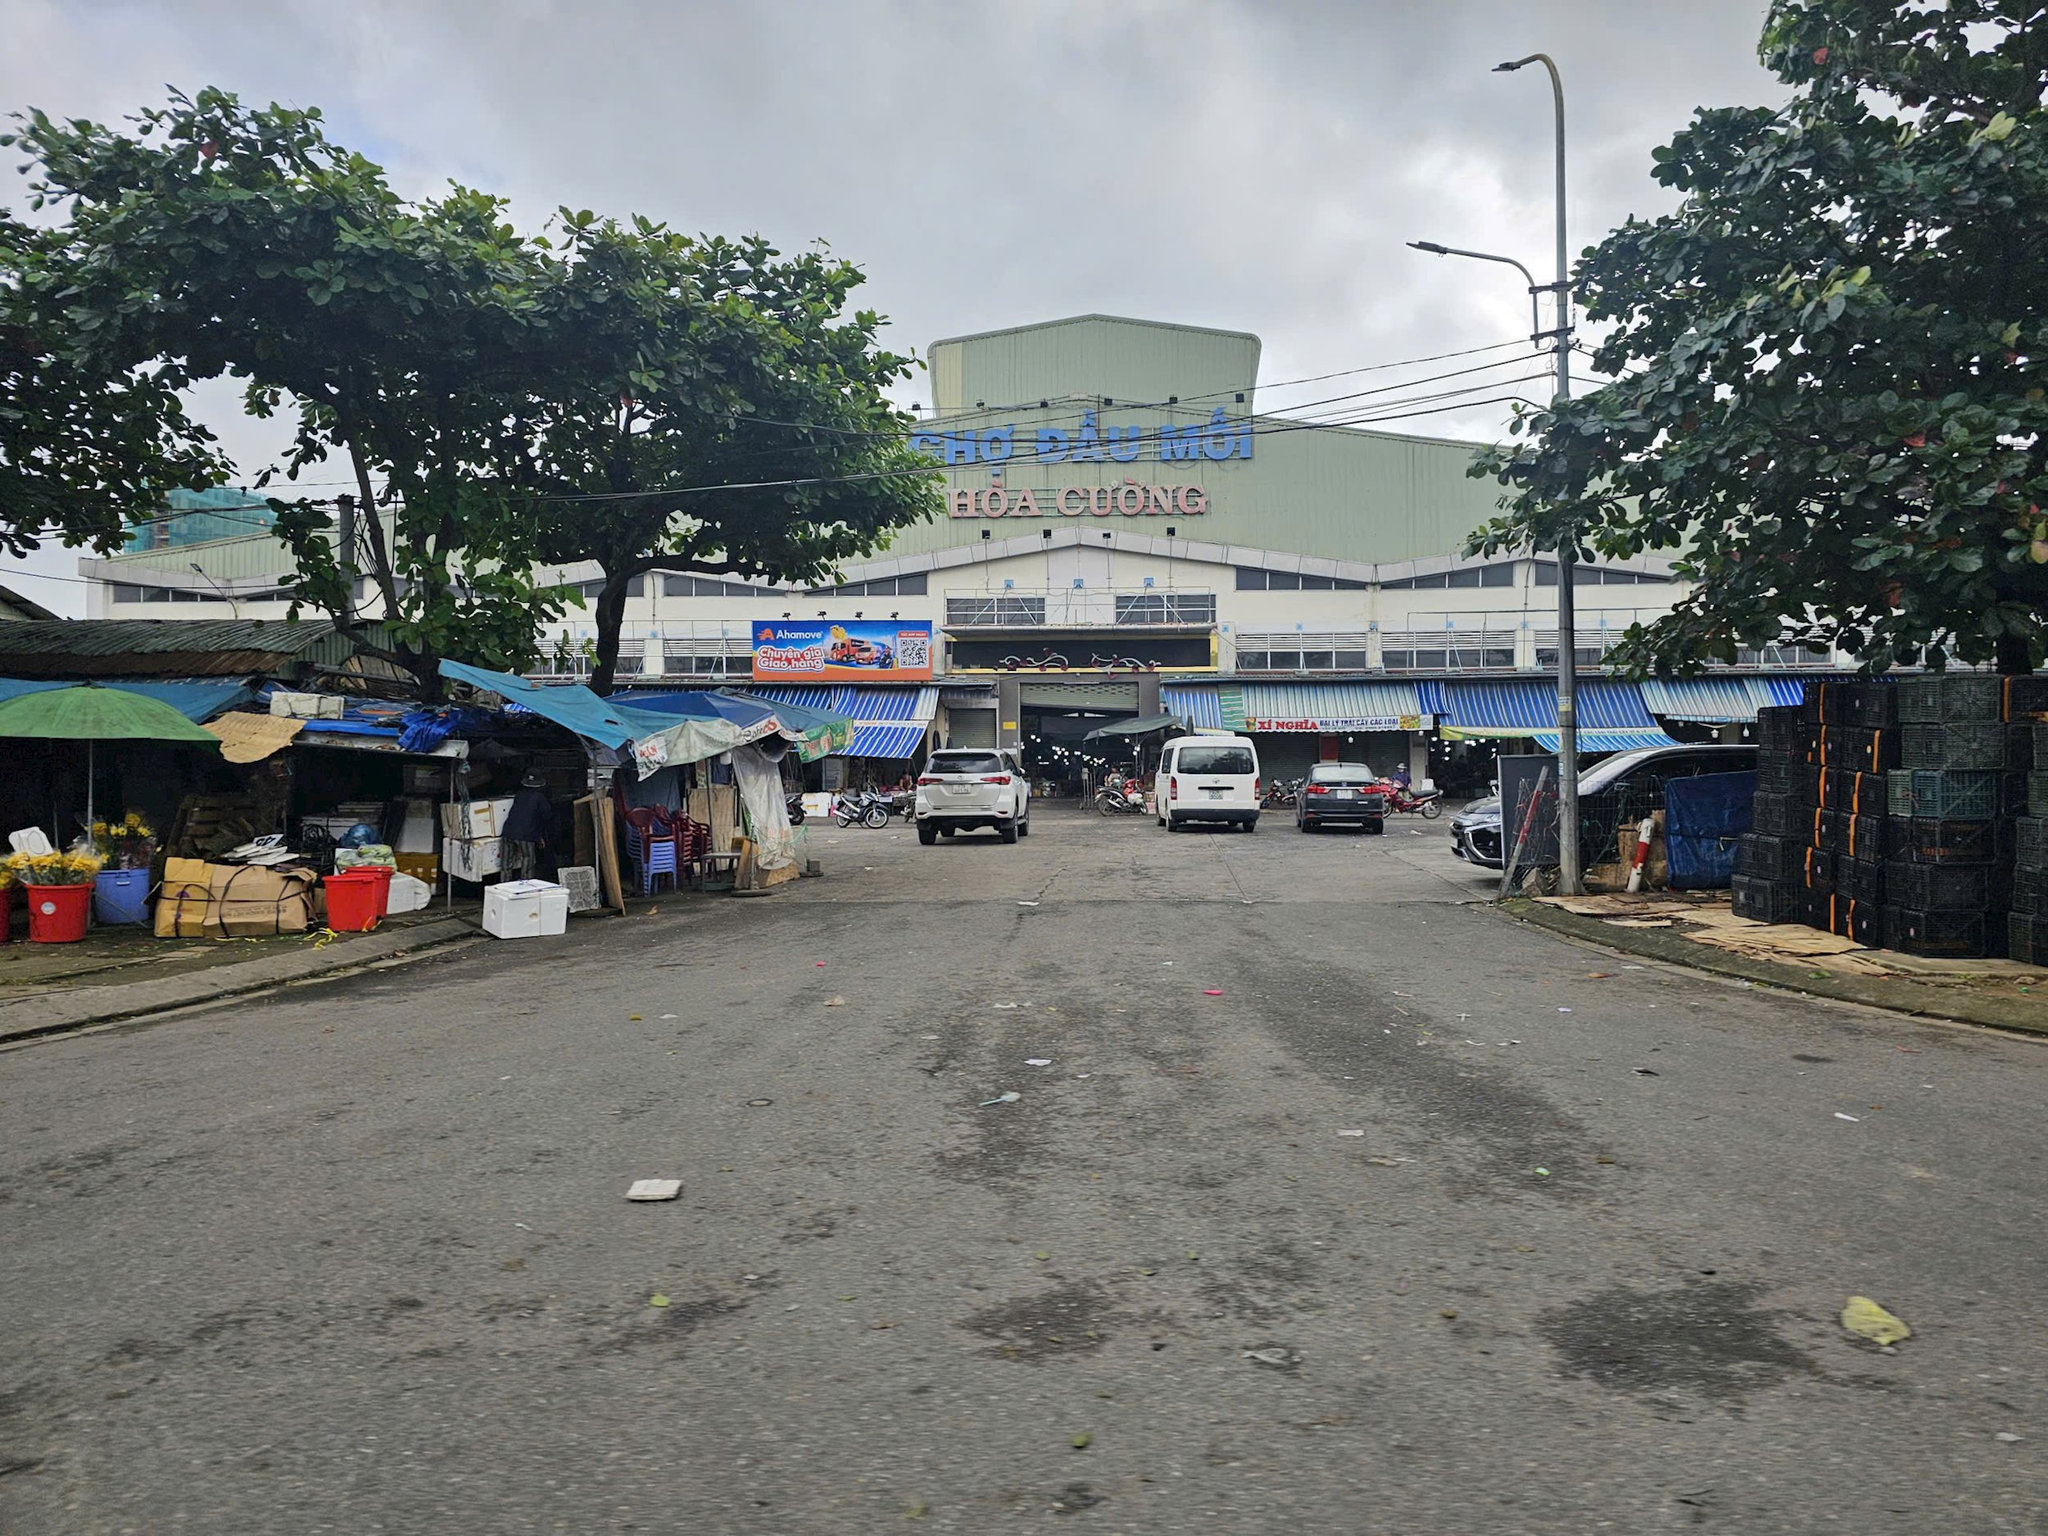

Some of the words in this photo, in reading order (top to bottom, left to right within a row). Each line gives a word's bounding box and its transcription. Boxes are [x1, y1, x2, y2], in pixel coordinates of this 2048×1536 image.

[908, 424, 1015, 475] CHỢ
[1033, 409, 1142, 462] ĐẦU
[1159, 405, 1254, 462] MỐI
[948, 477, 1041, 518] HÒA
[1056, 475, 1209, 517] CƯỜNG
[776, 629, 823, 640] Ahamove
[759, 646, 800, 660] Chuyên
[803, 646, 822, 660] gia
[759, 657, 788, 669] Giao
[791, 657, 822, 670] hàng
[1275, 719, 1319, 730] NGHĨA
